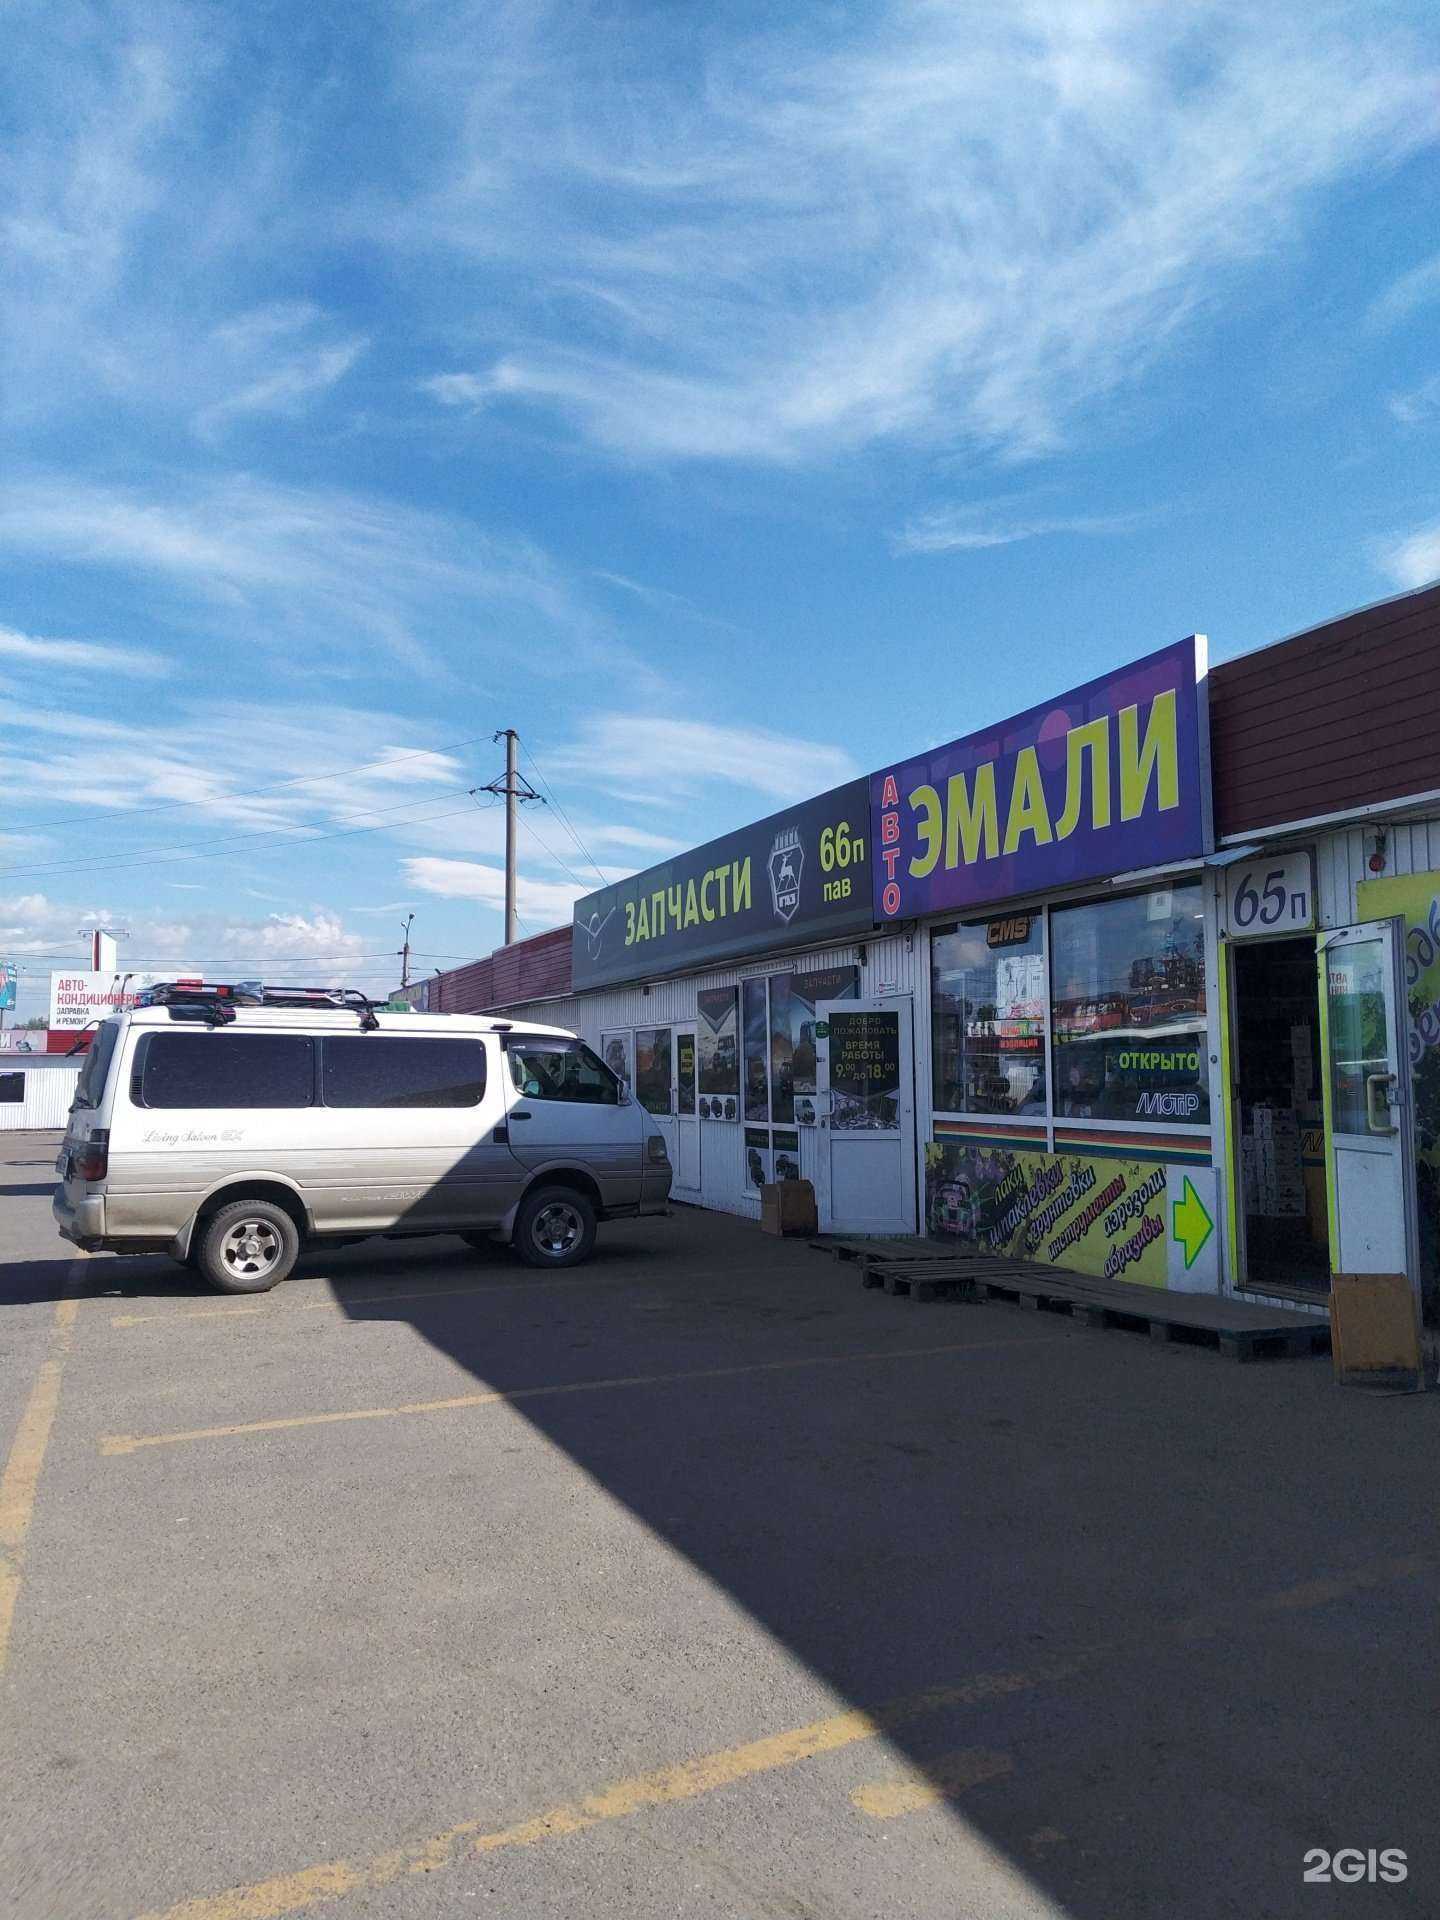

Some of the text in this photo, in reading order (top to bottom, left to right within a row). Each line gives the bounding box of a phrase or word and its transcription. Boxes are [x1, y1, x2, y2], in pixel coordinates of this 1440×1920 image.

[908, 688, 1179, 879] ЭМАЛИ
[881, 774, 900, 916] АВТО
[624, 856, 752, 946] ЗАПЧАСТИ
[823, 878, 852, 902] пав
[987, 917, 1028, 944] CMS
[841, 1050, 885, 1060] РАБОТЫ
[846, 1040, 880, 1050] ВРЕМЯ
[1118, 1052, 1201, 1070] ОТКРЫТО
[1104, 1167, 1166, 1238] аэрозоли
